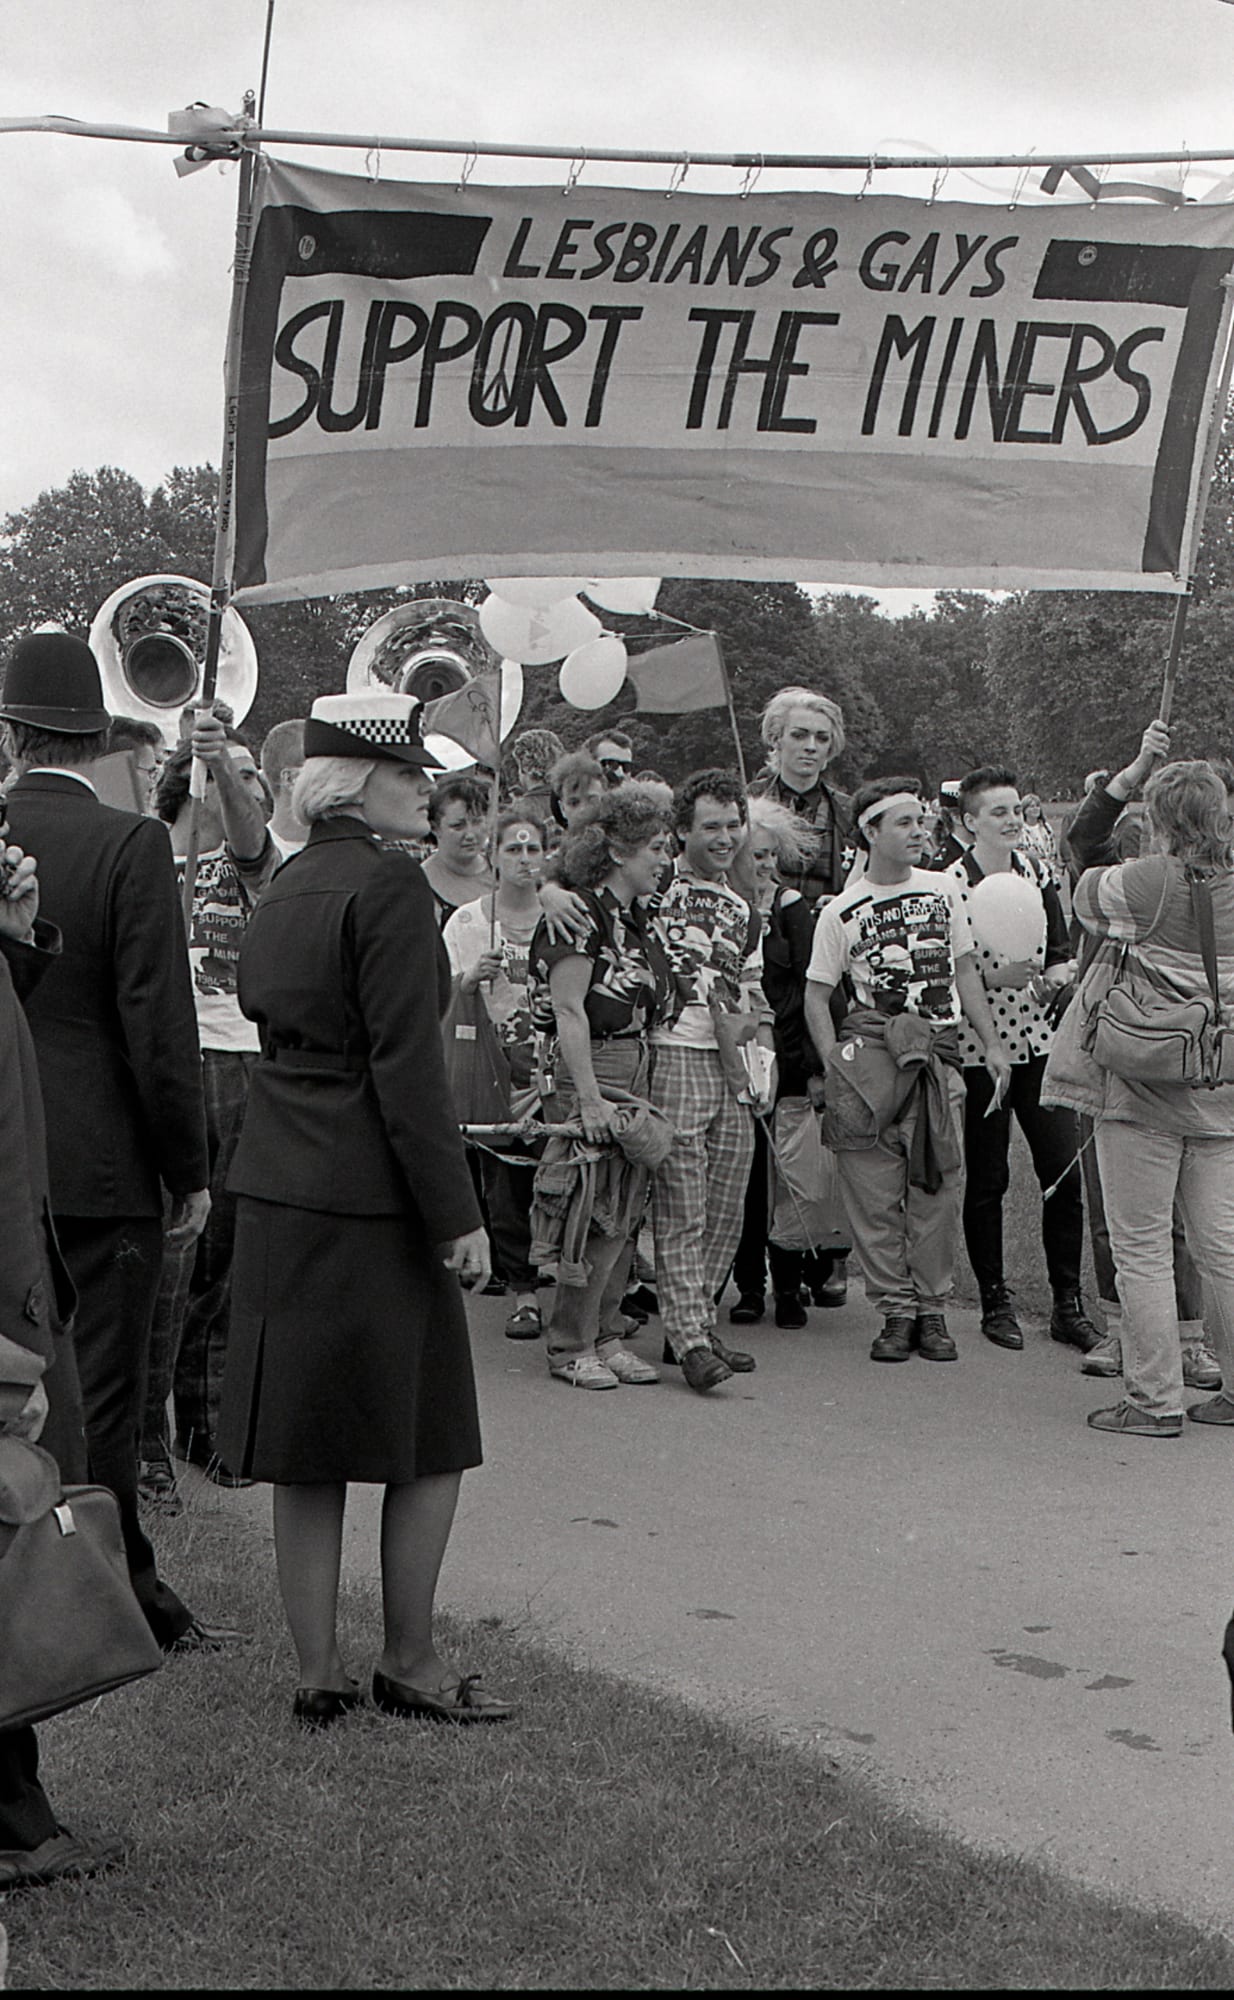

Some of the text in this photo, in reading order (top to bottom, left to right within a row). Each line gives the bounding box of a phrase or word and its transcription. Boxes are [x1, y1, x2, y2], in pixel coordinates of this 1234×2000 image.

[502, 216, 1019, 298] LESBIANS & GAYS
[267, 299, 1166, 446] SUPPORT THE MINERS
[882, 906, 901, 925] AND
[911, 922, 930, 934] GAY
[203, 930, 229, 943] THE
[920, 964, 940, 974] THE
